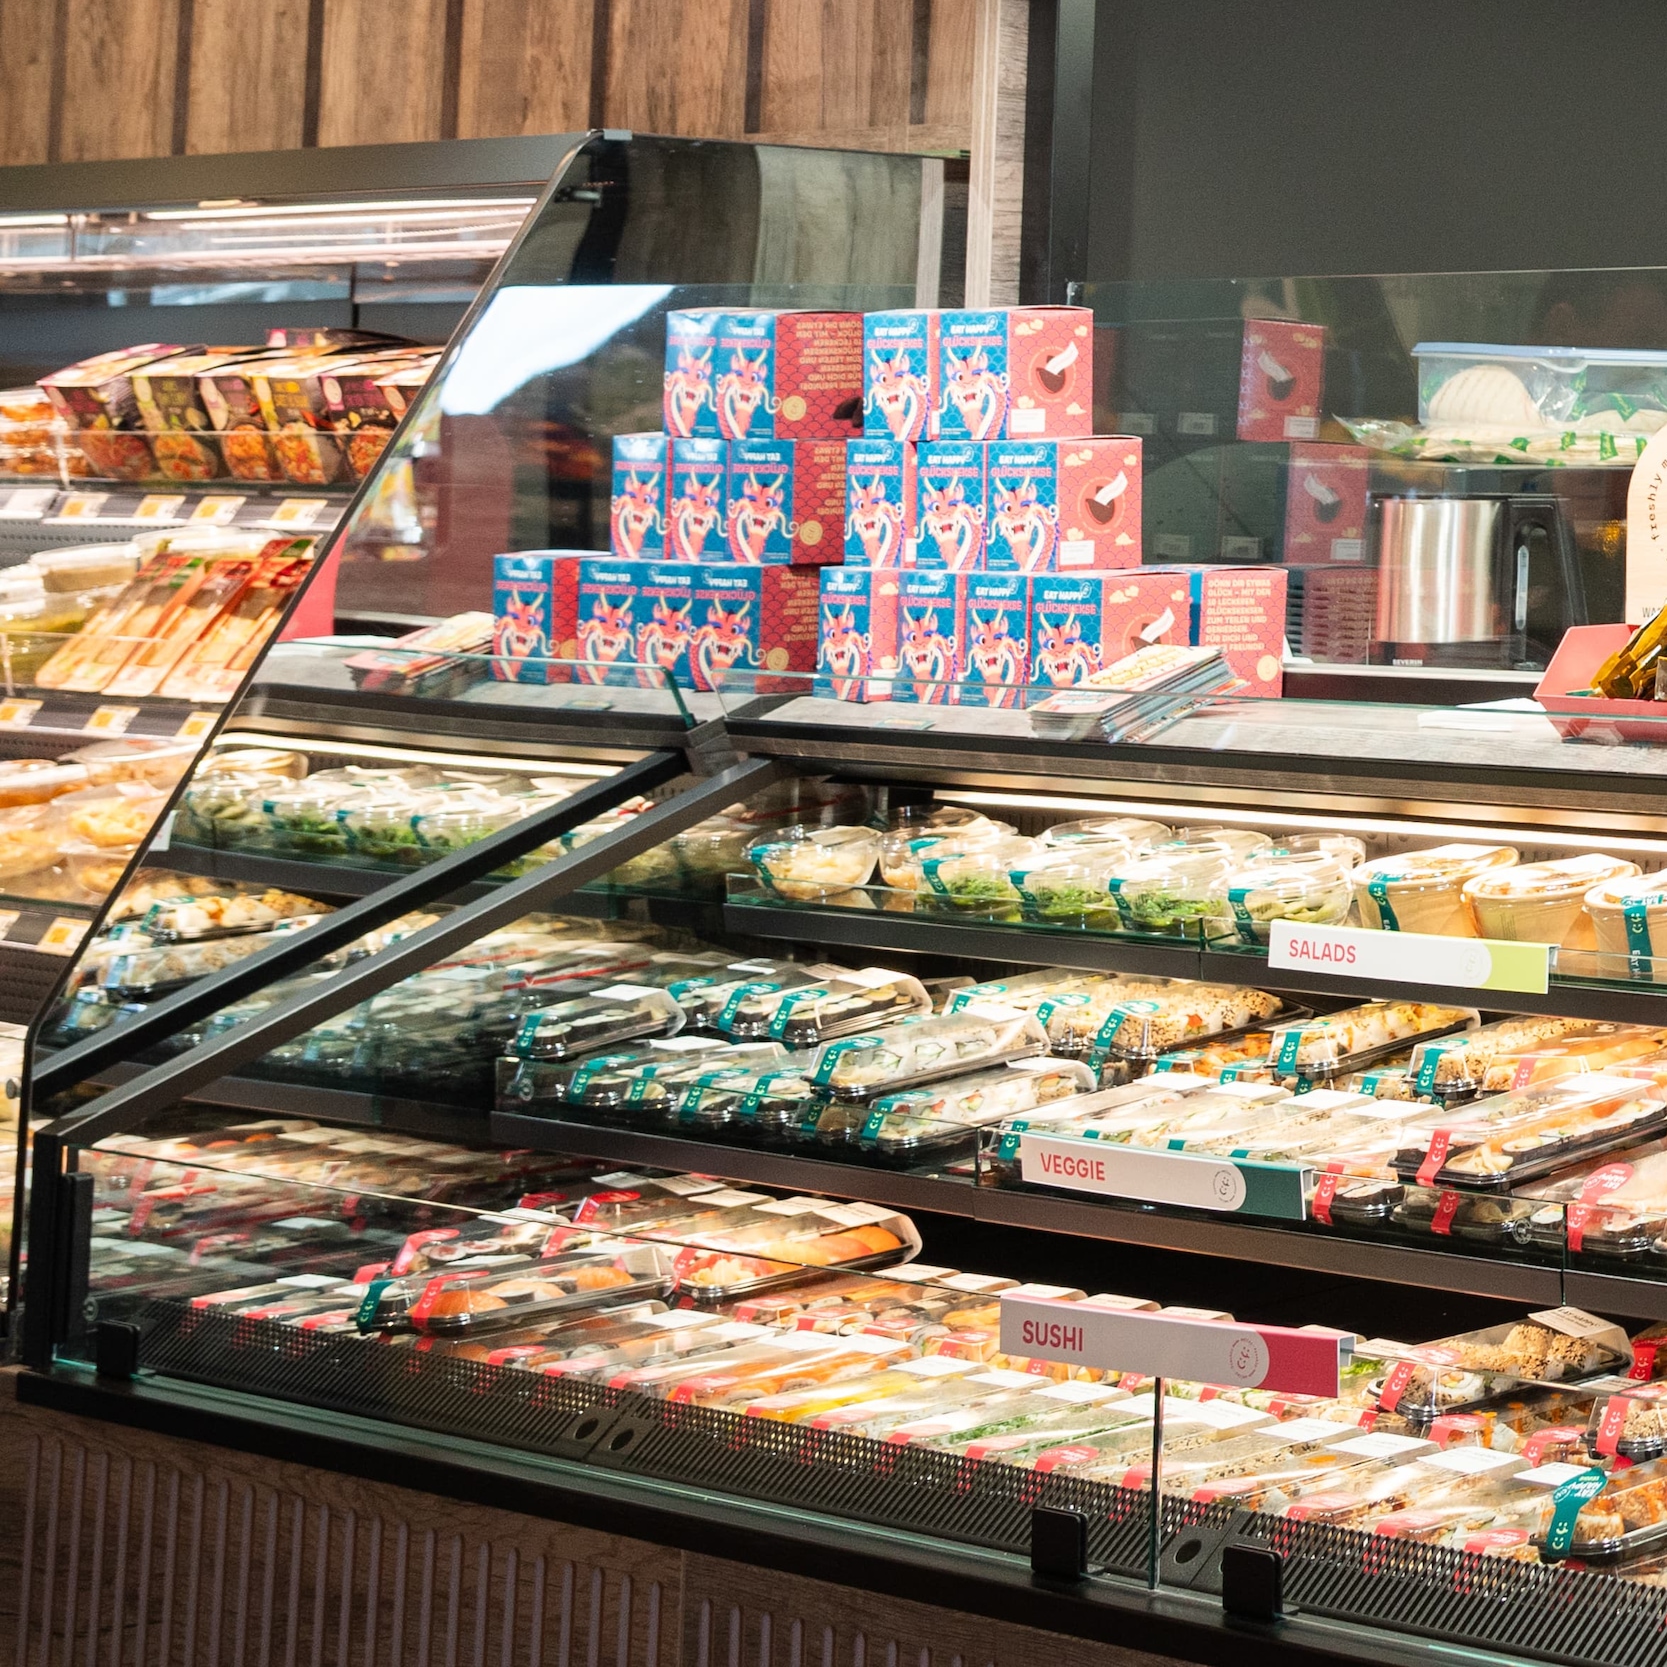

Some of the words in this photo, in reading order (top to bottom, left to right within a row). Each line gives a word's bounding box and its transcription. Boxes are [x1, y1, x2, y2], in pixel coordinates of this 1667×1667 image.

[1647, 473, 1663, 541] freshly
[1289, 938, 1357, 964] SALADS
[1039, 1151, 1106, 1182] VEGGIE
[1022, 1320, 1084, 1353] SUSHI
